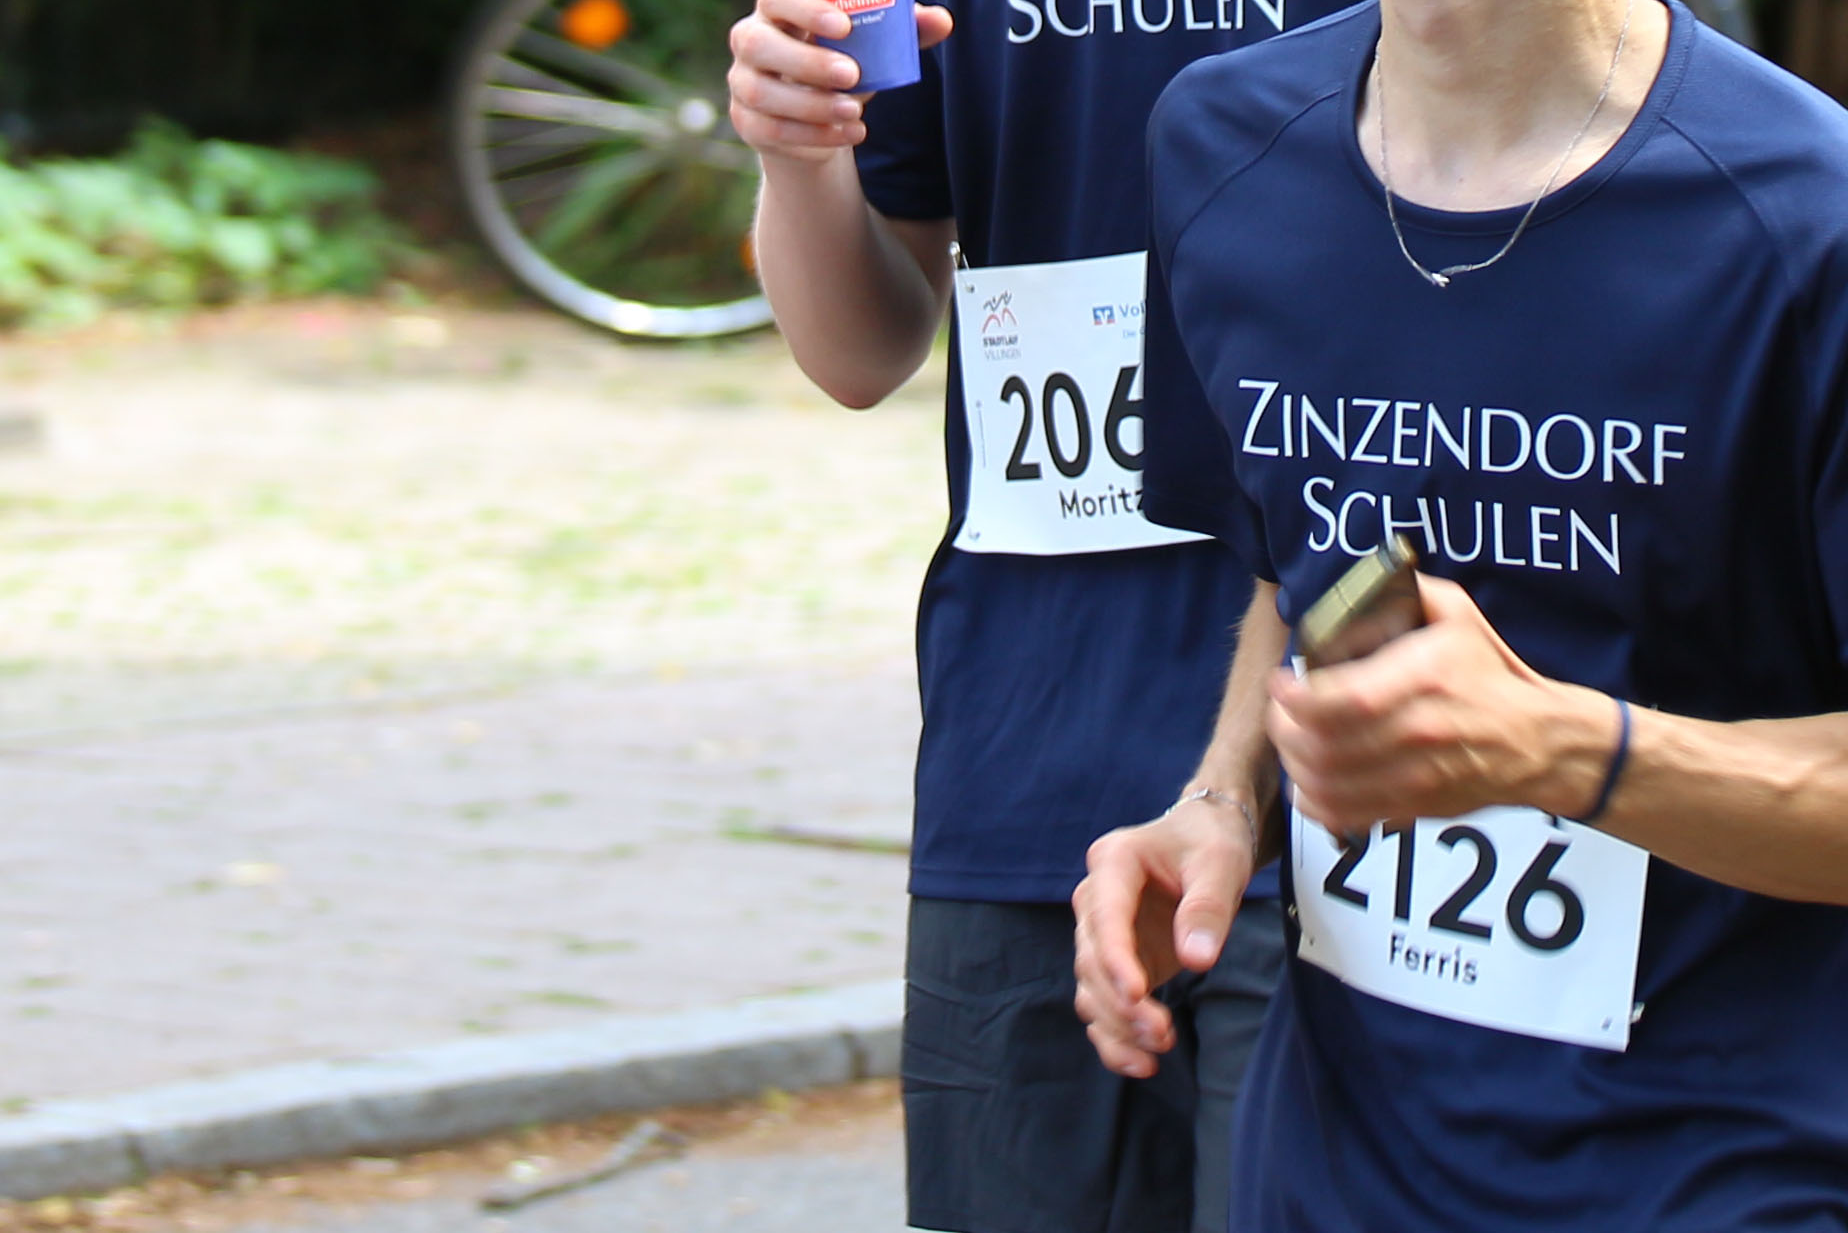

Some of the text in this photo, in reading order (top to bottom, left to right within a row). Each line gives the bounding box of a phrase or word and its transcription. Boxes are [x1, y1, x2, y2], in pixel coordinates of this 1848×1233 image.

[1239, 379, 1687, 485] ZINZENDORF
[1304, 478, 1621, 574] SCHULEN
[1323, 820, 1585, 951] 2126
[1390, 933, 1478, 984] Ferris
